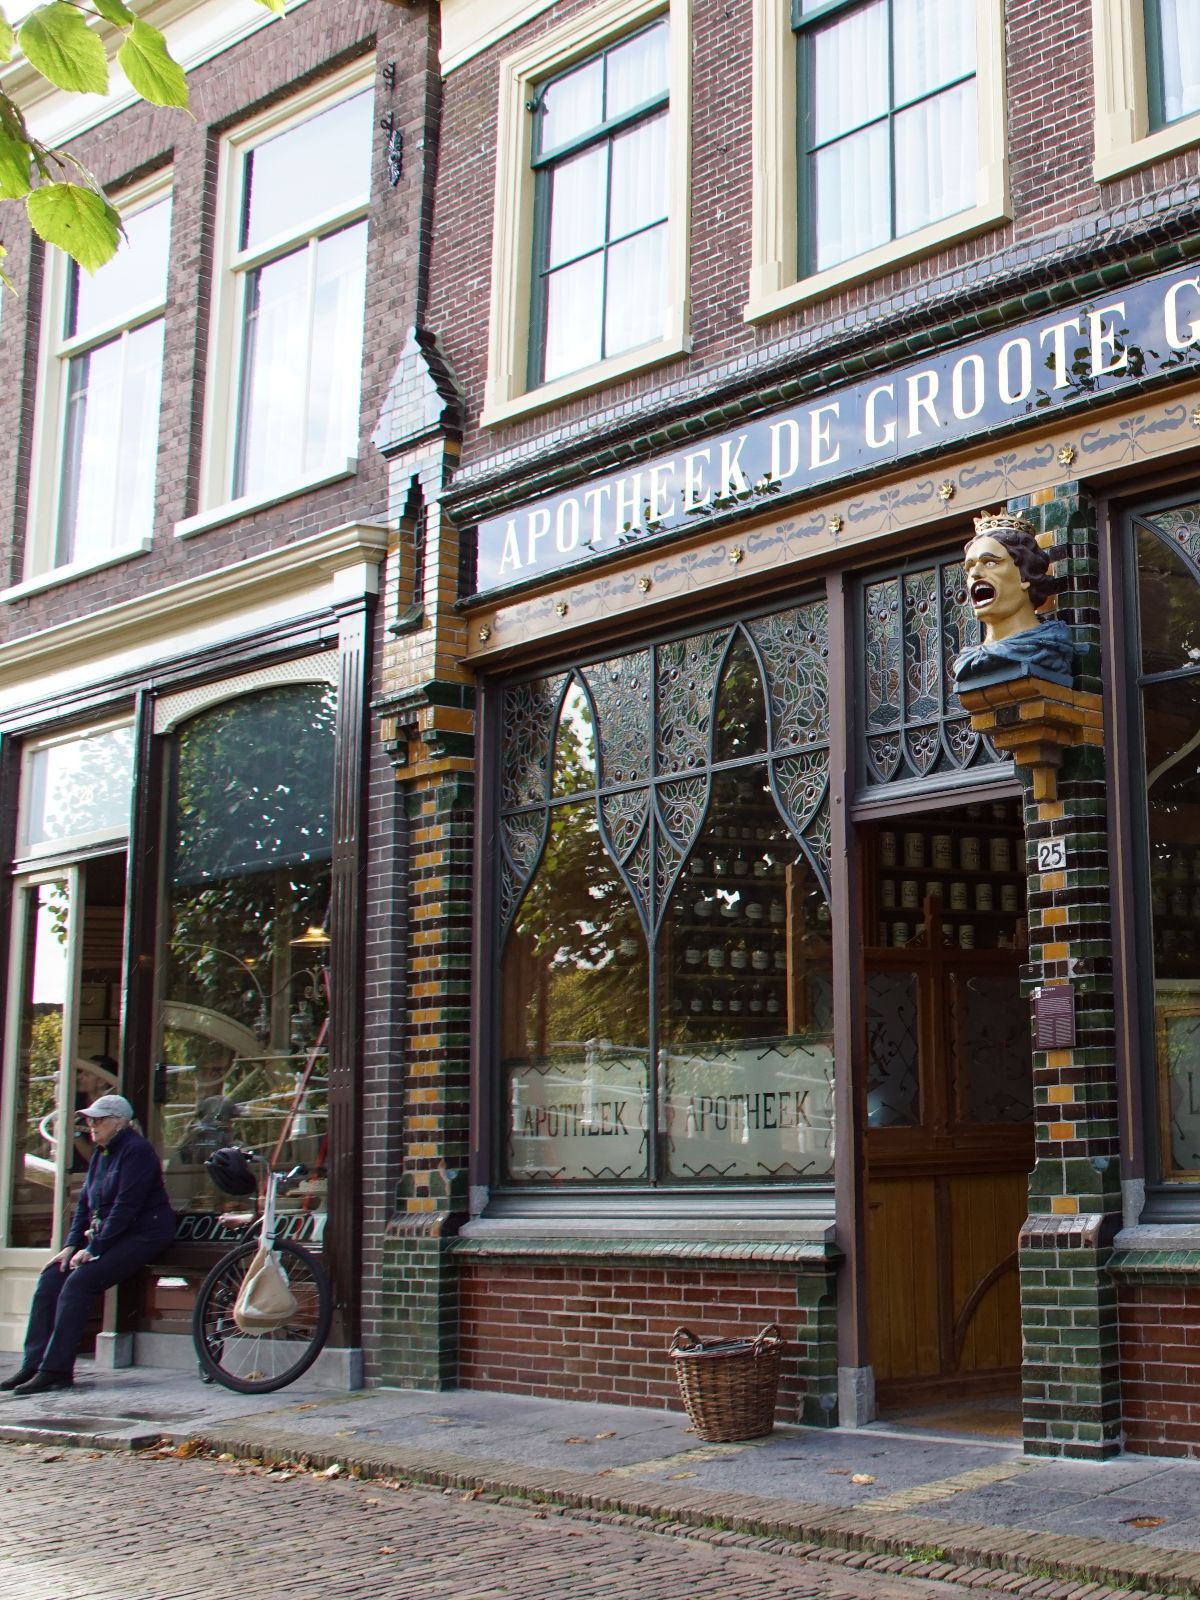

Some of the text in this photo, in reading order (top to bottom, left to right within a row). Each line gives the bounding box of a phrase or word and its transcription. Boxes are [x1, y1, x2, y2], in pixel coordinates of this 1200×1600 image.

[498, 434, 749, 575] APOTHEEK
[864, 301, 1129, 449] GROOTE
[1039, 842, 1063, 868] 25
[684, 1090, 812, 1132] APOTHEEK
